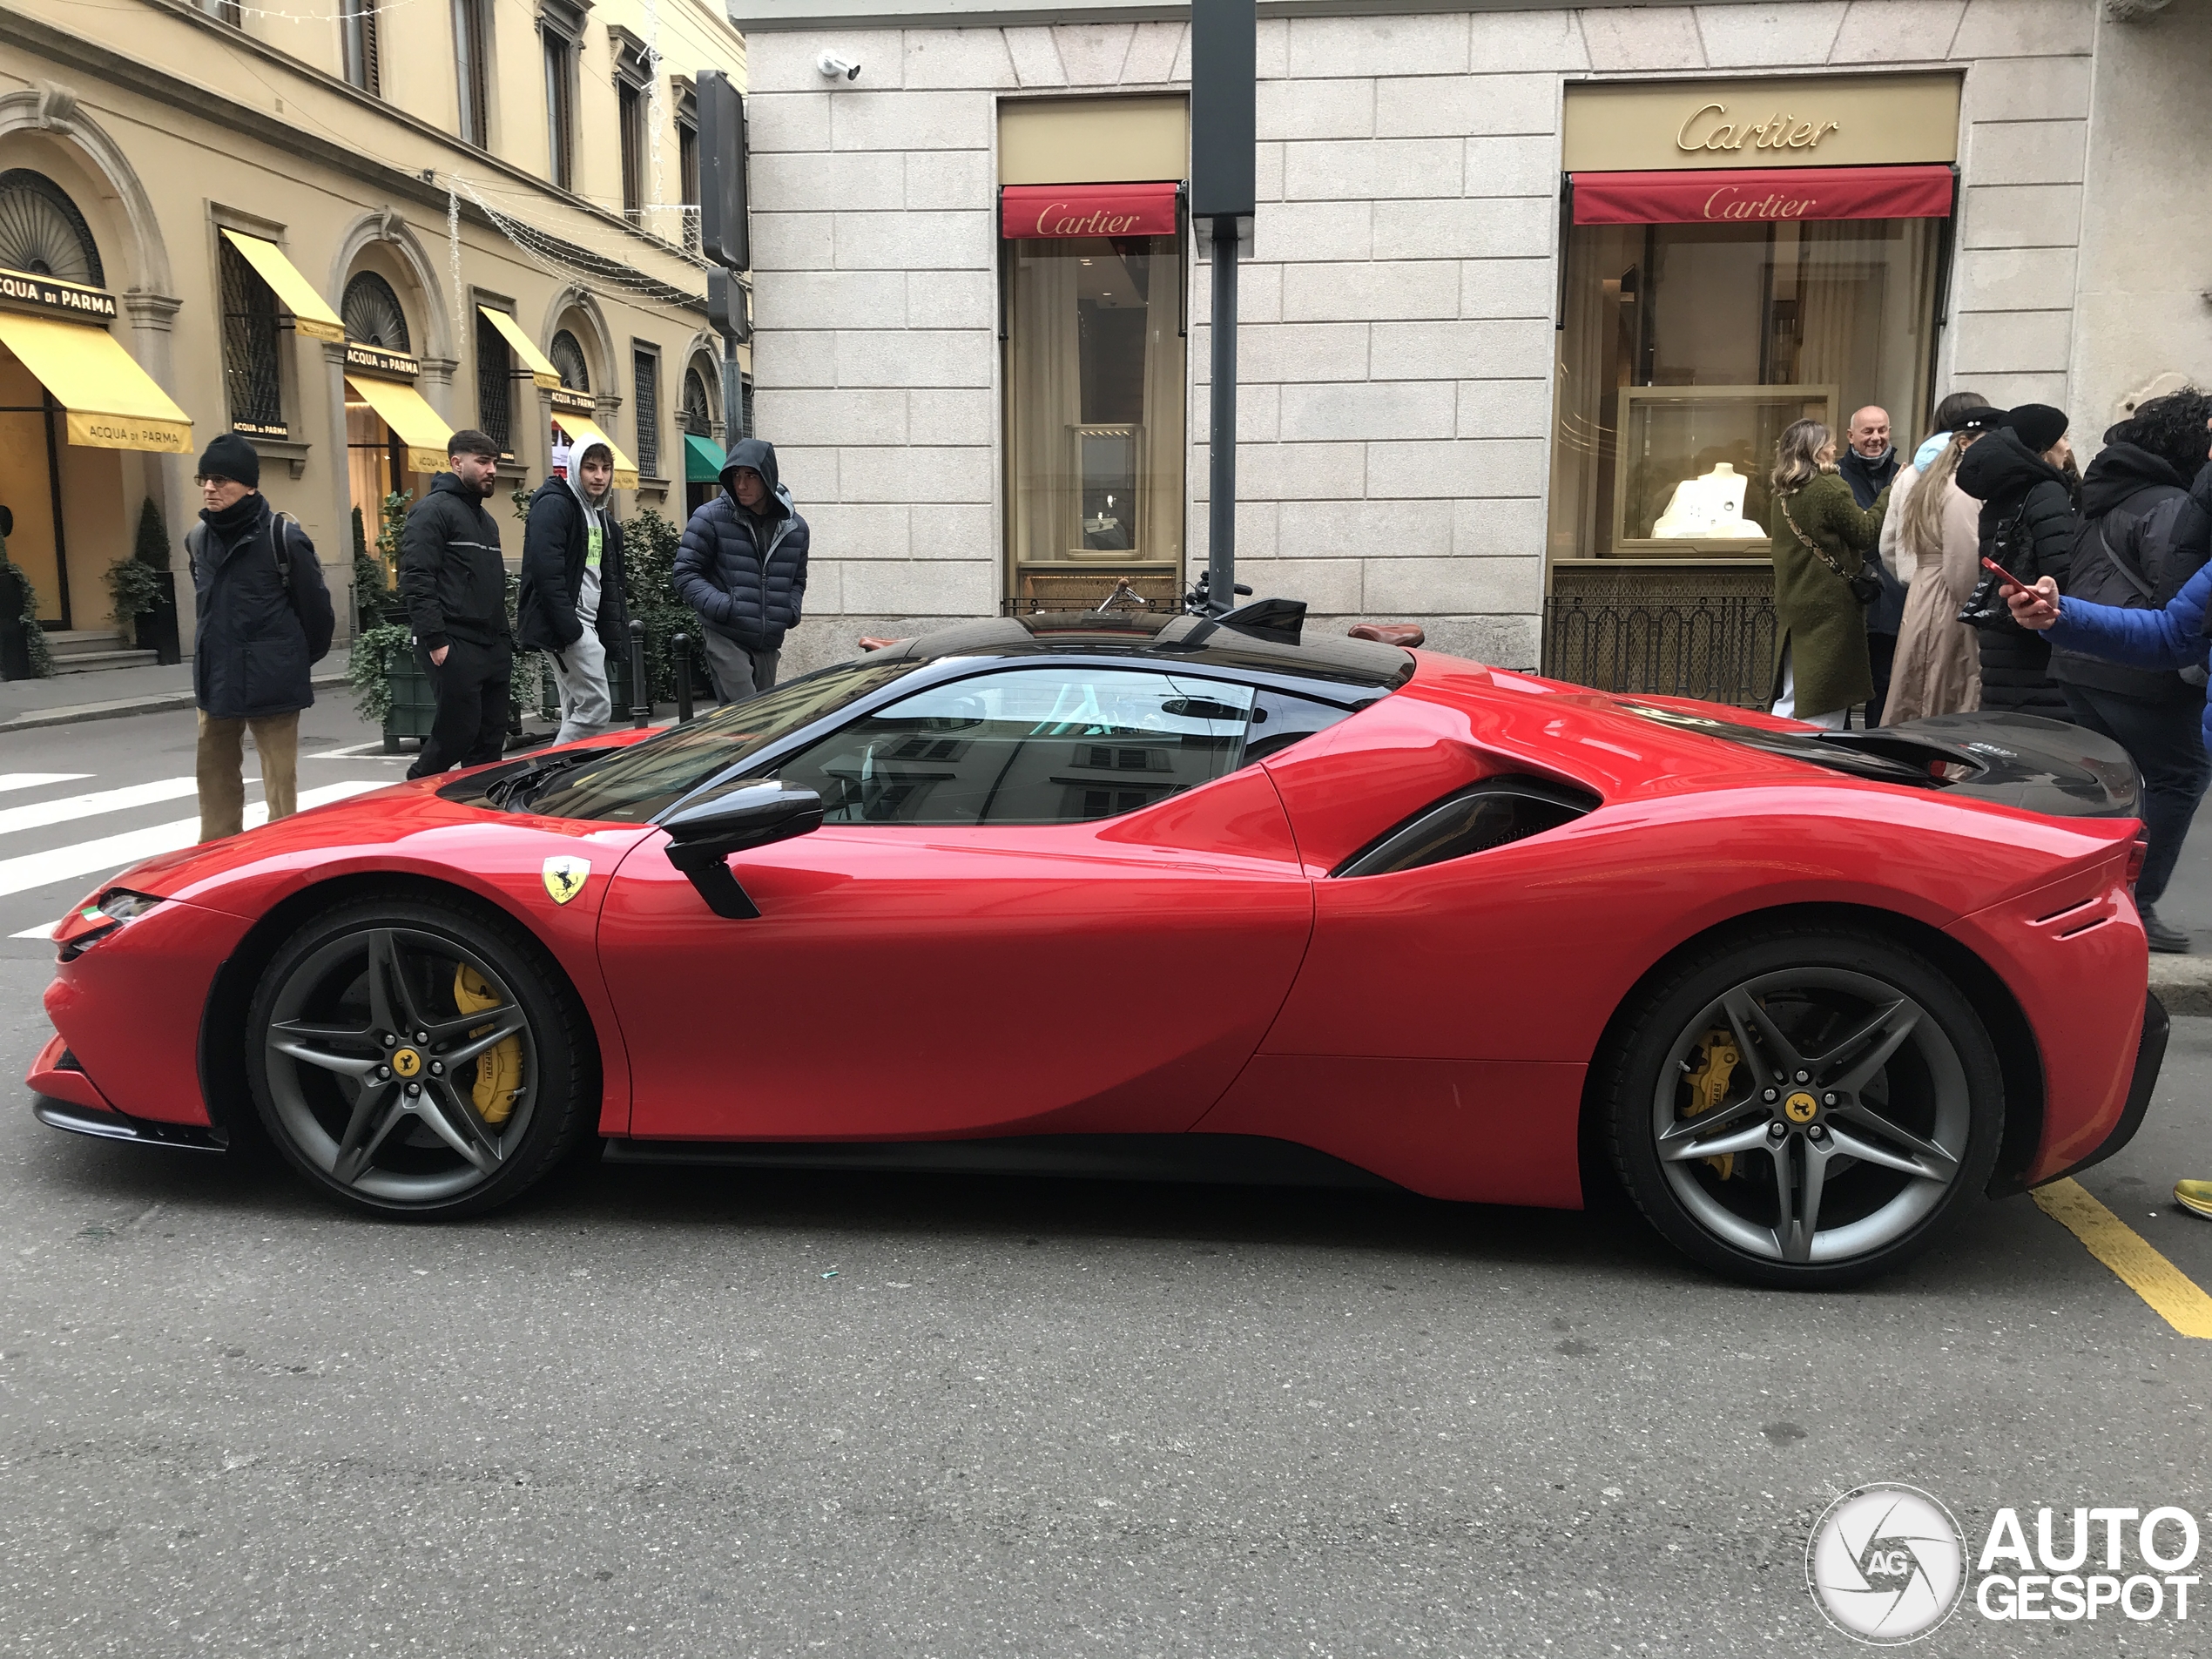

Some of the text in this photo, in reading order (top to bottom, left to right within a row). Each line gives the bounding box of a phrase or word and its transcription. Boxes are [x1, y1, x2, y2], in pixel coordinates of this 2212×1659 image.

[1670, 103, 1840, 151] Cartier
[1703, 186, 1817, 219] Cartier
[1036, 203, 1140, 235] Cartier
[44, 292, 57, 304] DI
[61, 290, 115, 315] PARMA
[347, 349, 378, 367] ACQUA
[388, 358, 418, 374] PARMA
[551, 392, 570, 405] ACQUA
[577, 397, 596, 409] PARMA
[90, 425, 128, 441] ACQUA
[142, 430, 179, 445] PARMA
[233, 421, 258, 432] ACQUA
[265, 425, 287, 435] PARMA
[419, 456, 439, 467] ACQUA
